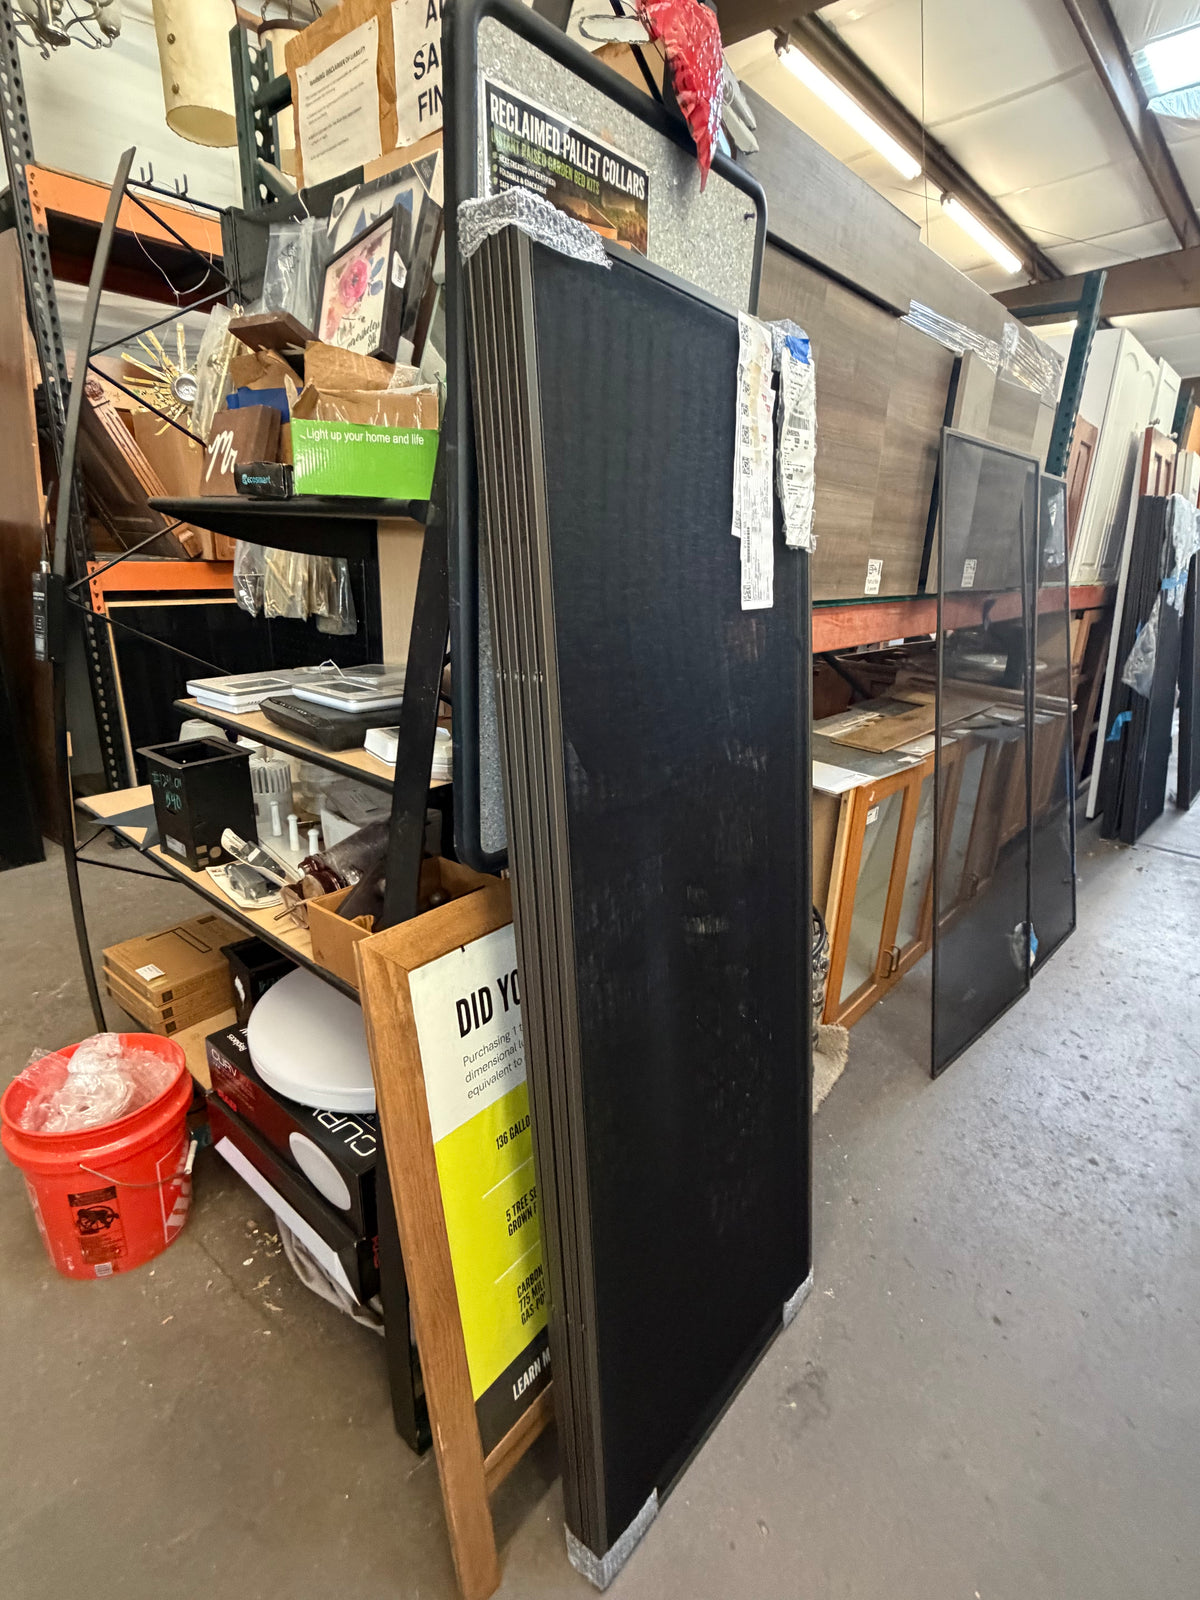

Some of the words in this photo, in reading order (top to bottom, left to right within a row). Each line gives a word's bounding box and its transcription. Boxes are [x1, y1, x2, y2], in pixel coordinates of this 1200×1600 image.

[489, 92, 560, 155] RECLAIMED
[562, 133, 601, 177] PALLET
[602, 155, 645, 200] COLLARS
[521, 142, 547, 168] RAISED
[547, 155, 573, 182] GARDEN
[574, 169, 586, 188] BED
[586, 175, 600, 196] KITS
[306, 427, 328, 442] Light
[330, 430, 342, 443] up
[343, 431, 364, 444] your
[365, 431, 391, 444] home
[392, 433, 409, 445] and
[411, 433, 424, 446] life
[455, 985, 494, 1039] DID
[463, 1032, 511, 1067] Purchasing
[464, 1042, 517, 1084] dimensional
[467, 1064, 512, 1100] equivalent
[513, 1057, 523, 1069] to
[495, 1130, 508, 1150] 136
[505, 1208, 512, 1222] 5
[512, 1193, 528, 1217] TREE
[507, 1205, 533, 1237] GROWN
[517, 1264, 543, 1299] CARBON
[519, 1291, 531, 1313] 775
[512, 1356, 541, 1401] LEARN
